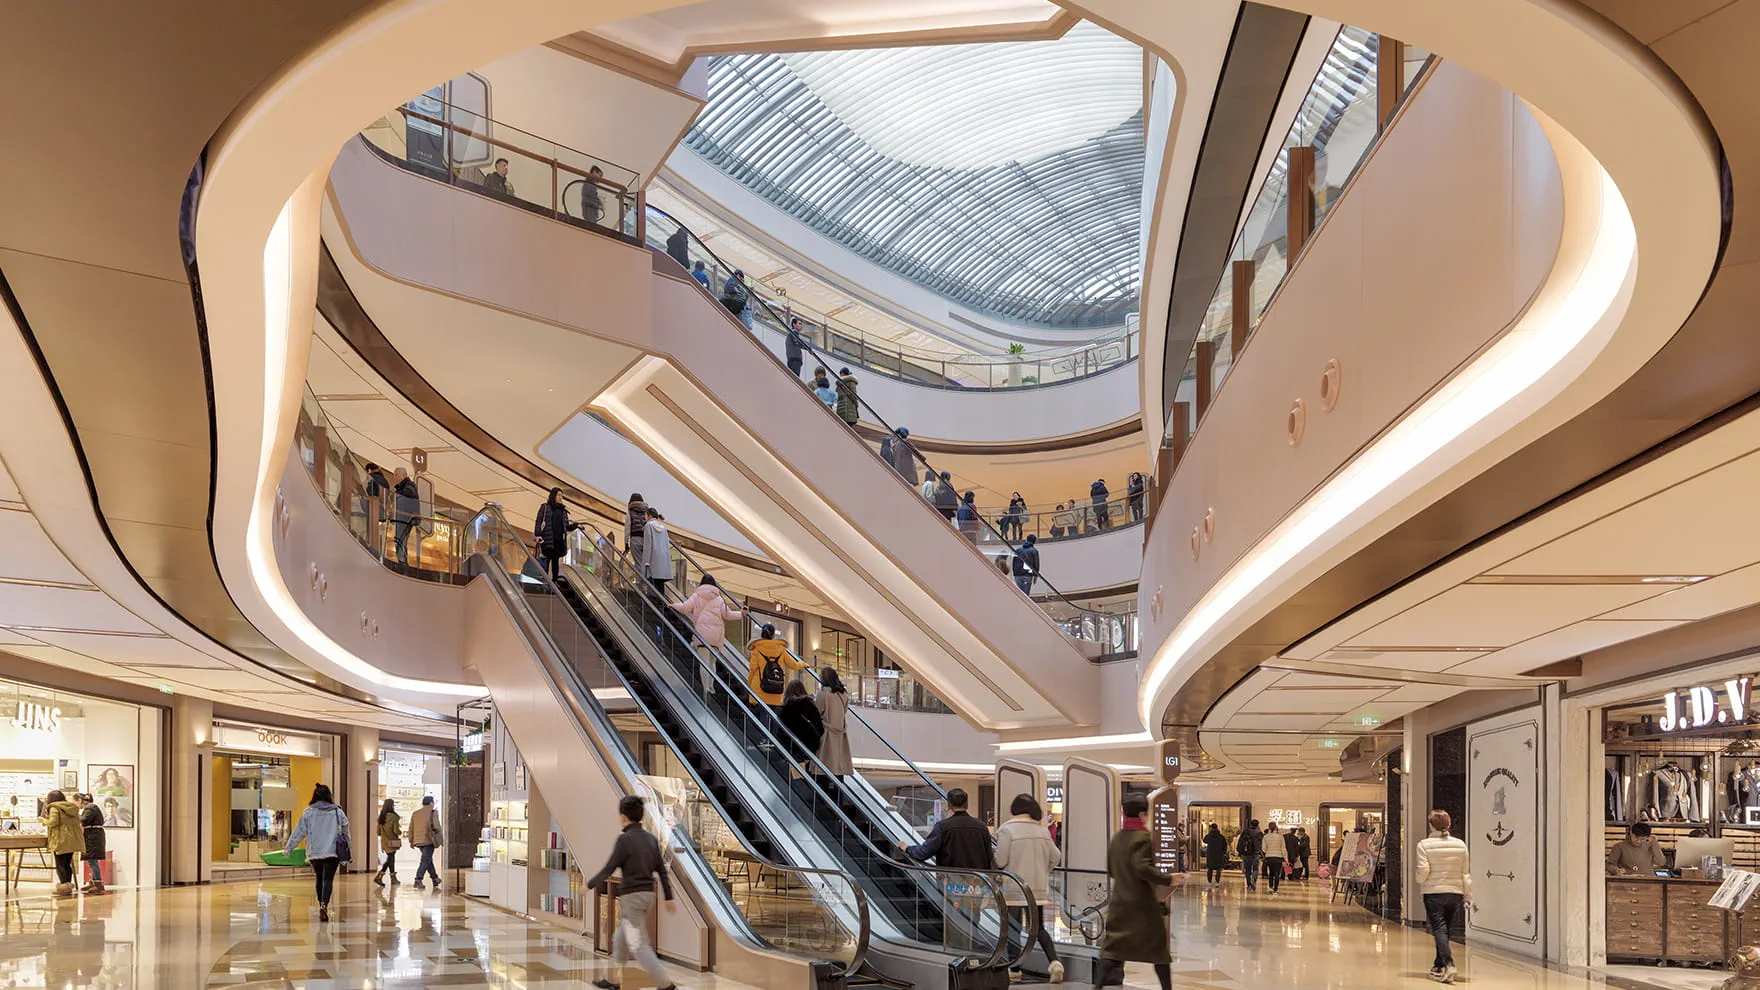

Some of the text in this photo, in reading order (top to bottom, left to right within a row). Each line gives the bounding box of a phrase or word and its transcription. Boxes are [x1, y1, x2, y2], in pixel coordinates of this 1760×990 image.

[416, 455, 424, 464] L1
[11, 701, 61, 734] JINS
[1165, 756, 1178, 767] LG1
